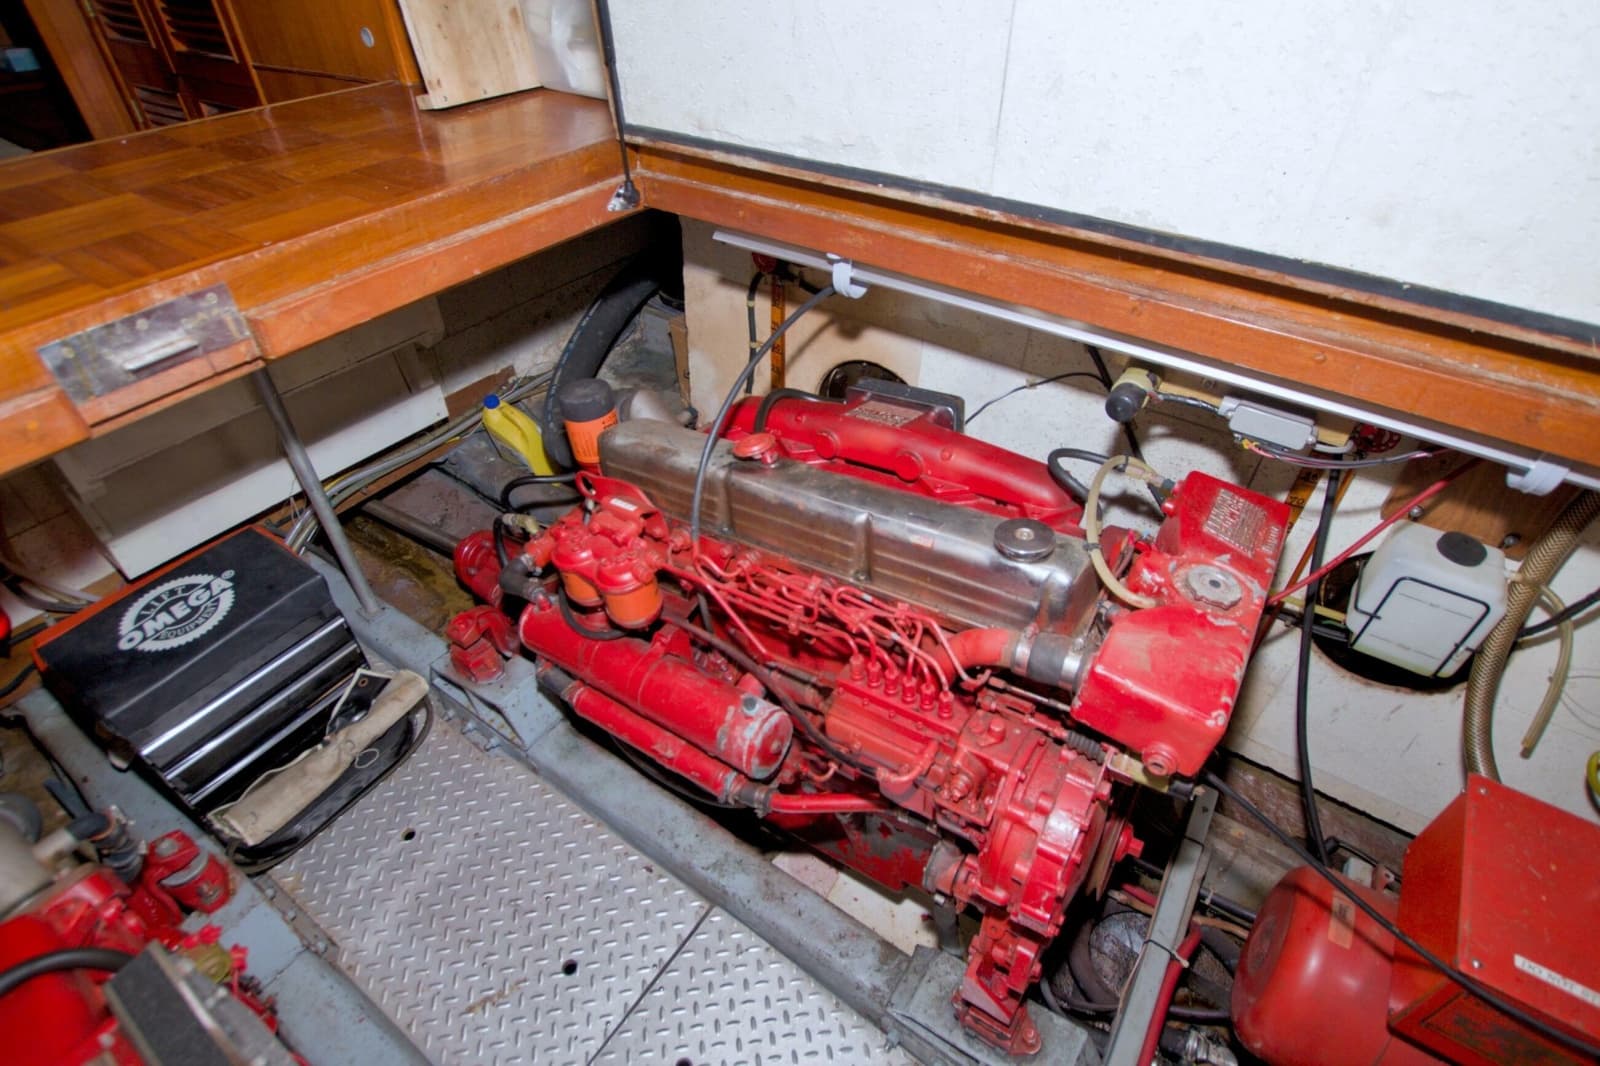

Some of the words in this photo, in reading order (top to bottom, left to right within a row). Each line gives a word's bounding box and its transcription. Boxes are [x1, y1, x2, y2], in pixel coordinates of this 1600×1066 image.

[118, 577, 234, 650] OMEGA
[141, 585, 185, 616] LIFT
[158, 600, 219, 639] EQUIPMENT
